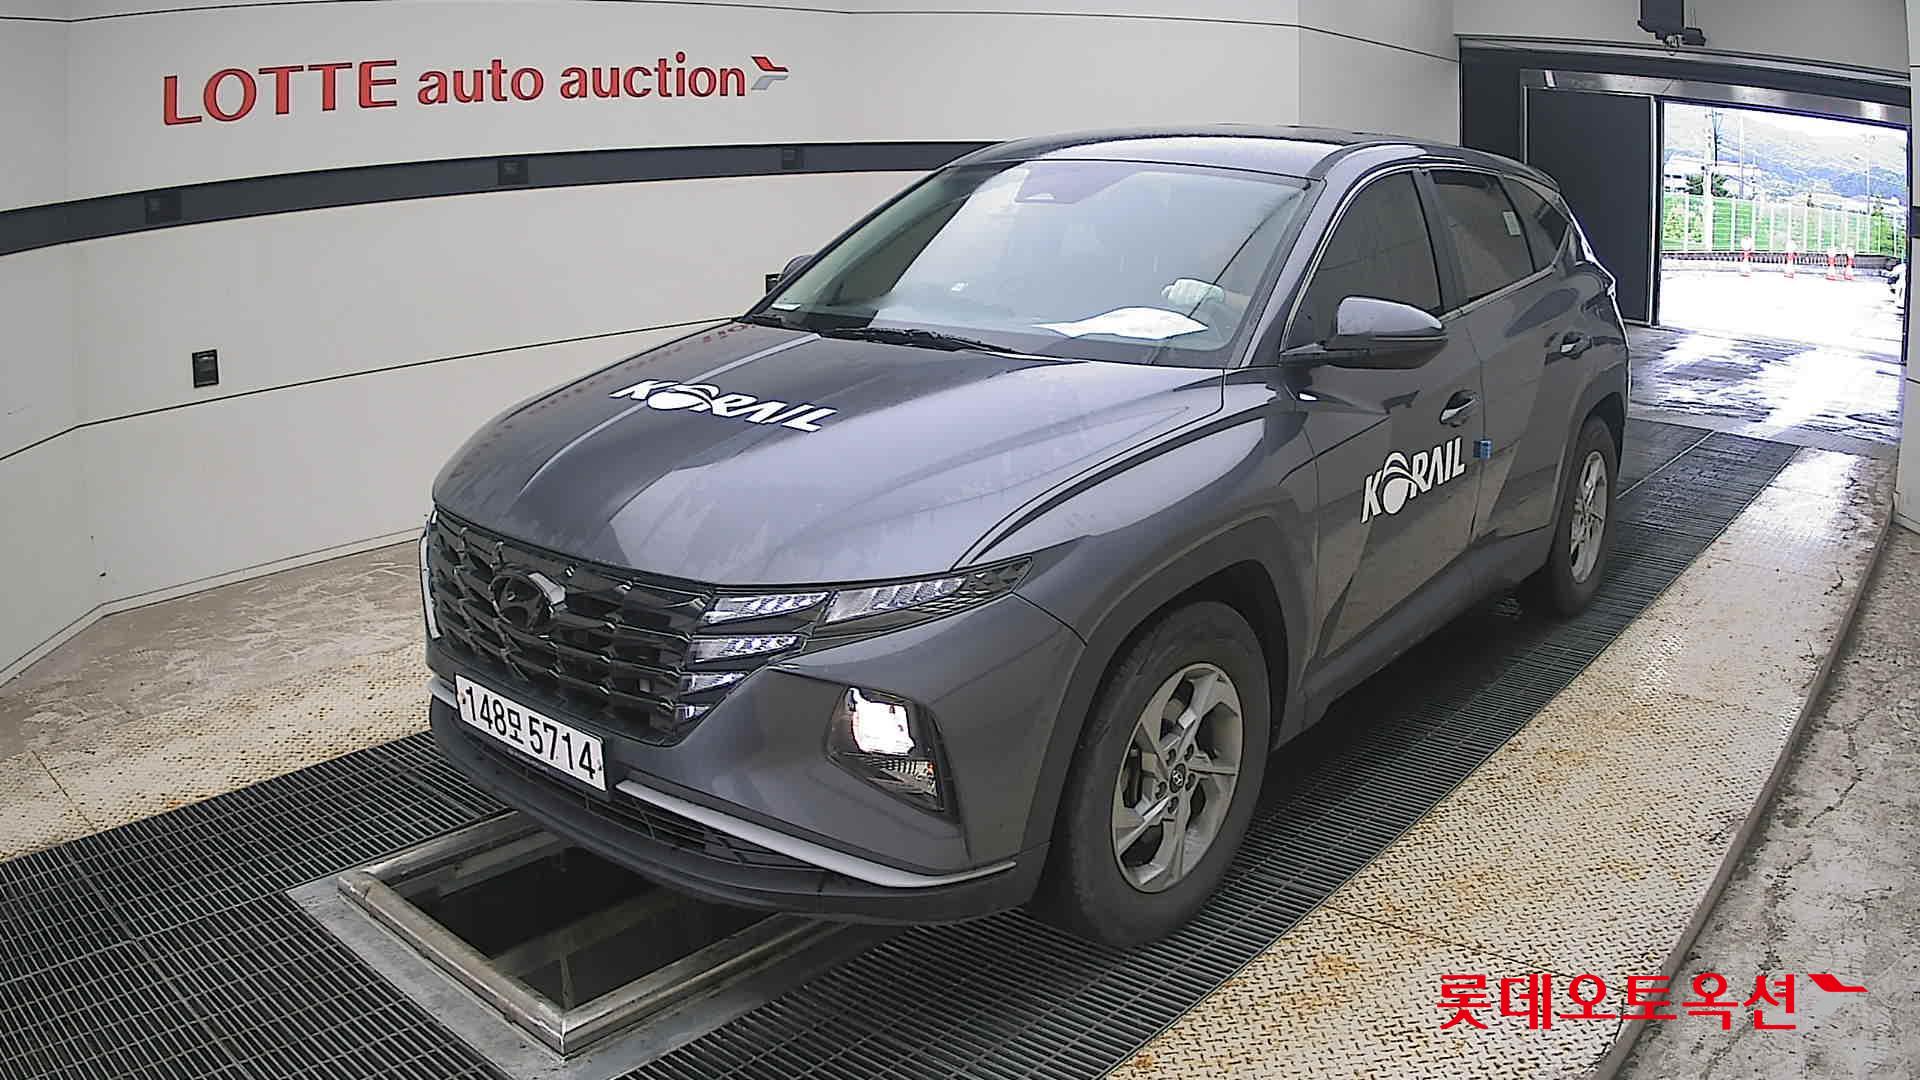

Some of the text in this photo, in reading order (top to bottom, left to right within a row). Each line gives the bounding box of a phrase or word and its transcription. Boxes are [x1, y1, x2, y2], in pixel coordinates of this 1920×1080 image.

[163, 51, 746, 126] LOTTE auto auction
[608, 379, 838, 432] KORAIL
[1361, 437, 1466, 523] KORAIL
[465, 686, 597, 780] 148모 5714
